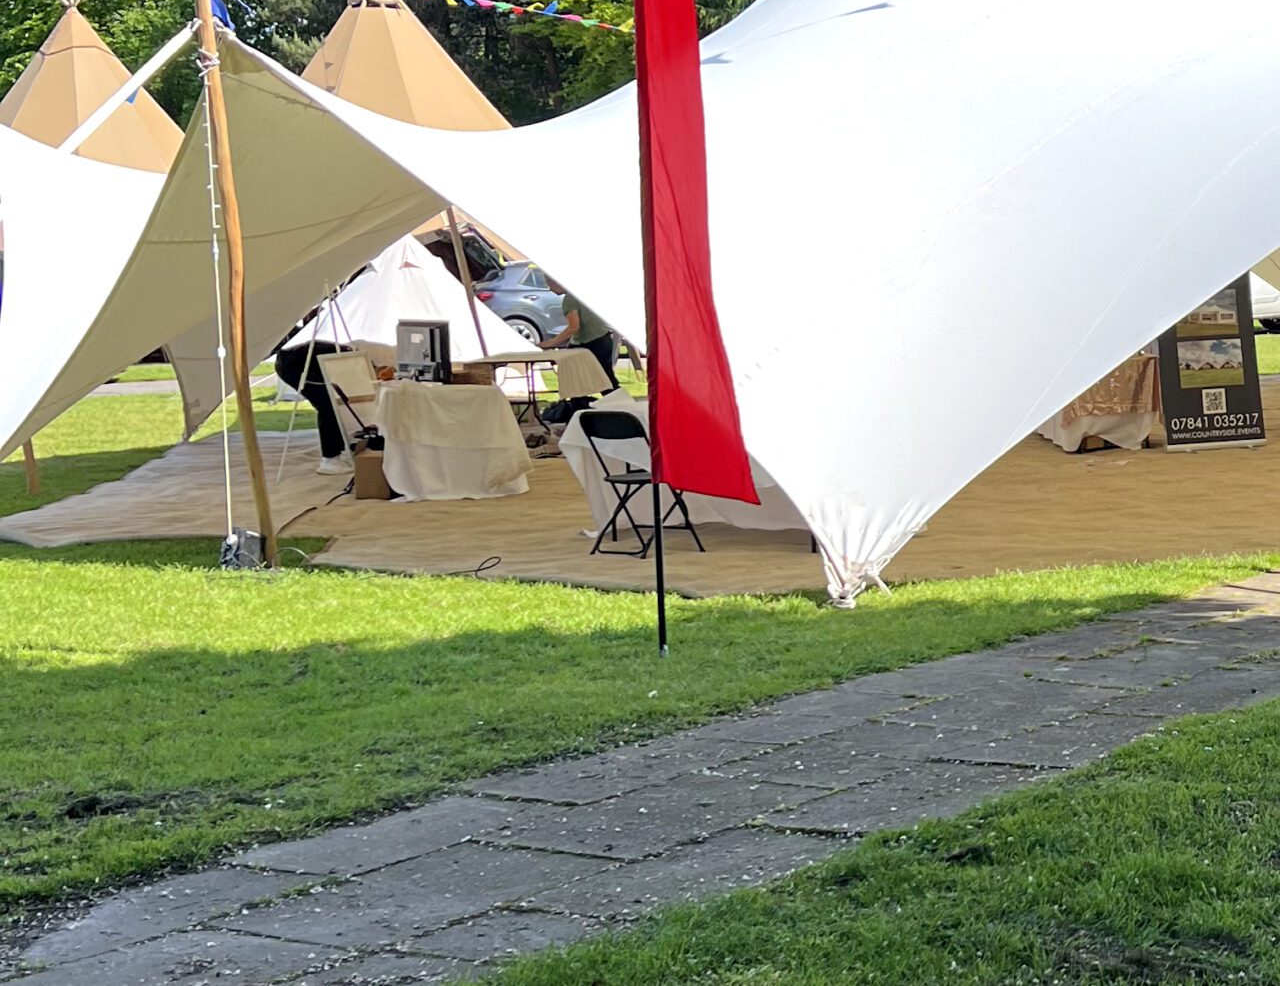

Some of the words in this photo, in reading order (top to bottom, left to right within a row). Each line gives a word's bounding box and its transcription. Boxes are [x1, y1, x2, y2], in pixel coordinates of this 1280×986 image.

[1171, 416, 1209, 430] 07841
[1213, 413, 1259, 428] 035217
[1171, 427, 1261, 439] WWW.COUNTRYSIDE.EVENTS
